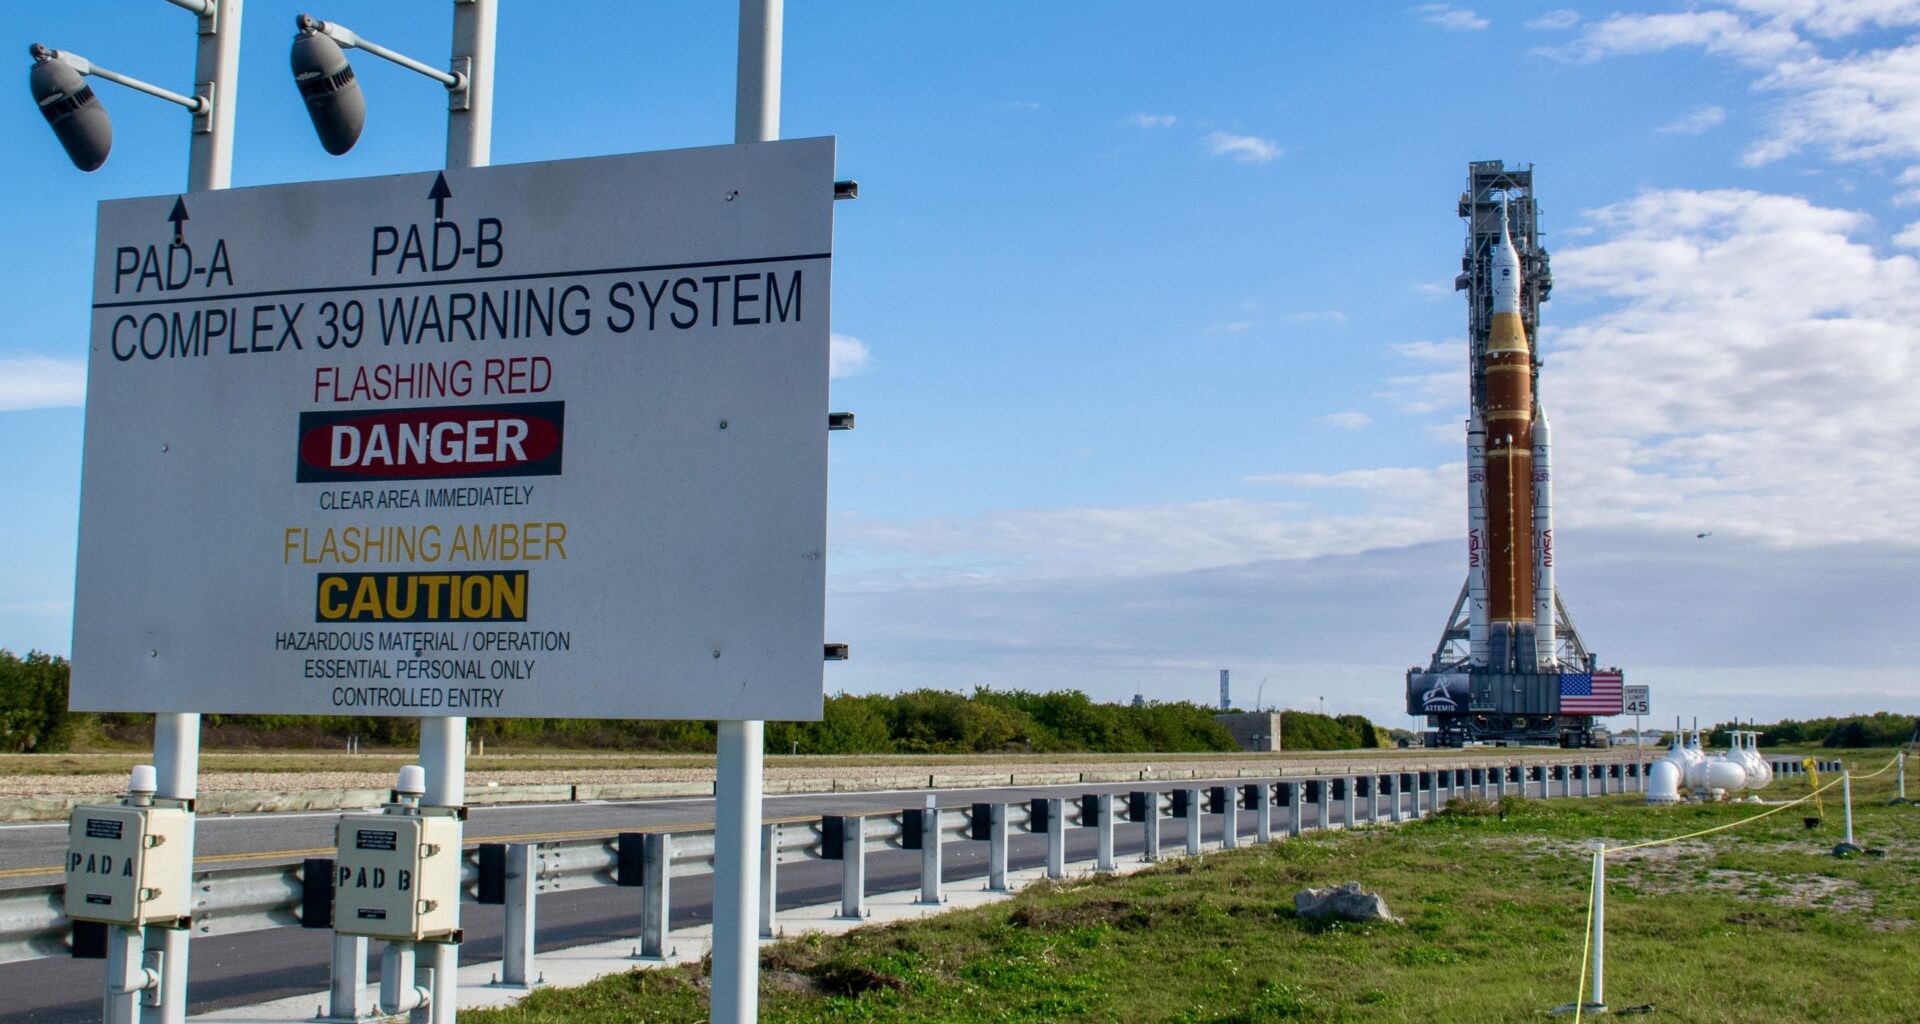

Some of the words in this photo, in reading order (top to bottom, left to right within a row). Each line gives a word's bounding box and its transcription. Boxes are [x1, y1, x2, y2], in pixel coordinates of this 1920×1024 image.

[371, 217, 503, 276] PAD-B
[115, 238, 234, 294] PAD-A
[111, 303, 304, 361] COMPLEX
[317, 301, 364, 349] 39
[379, 285, 592, 347] WARNING
[607, 269, 802, 334] SYSTEM
[313, 361, 475, 402] FLASHING
[484, 355, 553, 396] RED
[330, 419, 528, 467] DANGER
[319, 489, 374, 510] CLEAR
[376, 489, 421, 509] AREA
[425, 485, 534, 508] IMMEDIATELY
[283, 525, 442, 564] FLASHING
[449, 522, 568, 562] AMBER
[318, 574, 526, 620] CAUTION
[275, 631, 374, 651] HAZARDOUS
[378, 631, 459, 651] MATERIAL
[463, 632, 469, 652] /
[472, 631, 570, 651] OPERATION
[304, 659, 391, 679] ESSENTIAL
[396, 659, 486, 679] PERSONAL
[490, 659, 535, 680] ONLY
[332, 687, 442, 707] CONTROLLED
[448, 688, 504, 708] ENTRY
[1425, 704, 1455, 712] ARTEMIS
[1627, 701, 1648, 712] 45
[71, 852, 112, 875] PAD
[122, 857, 133, 877] A
[339, 866, 385, 889] PAD
[398, 869, 411, 891] B
